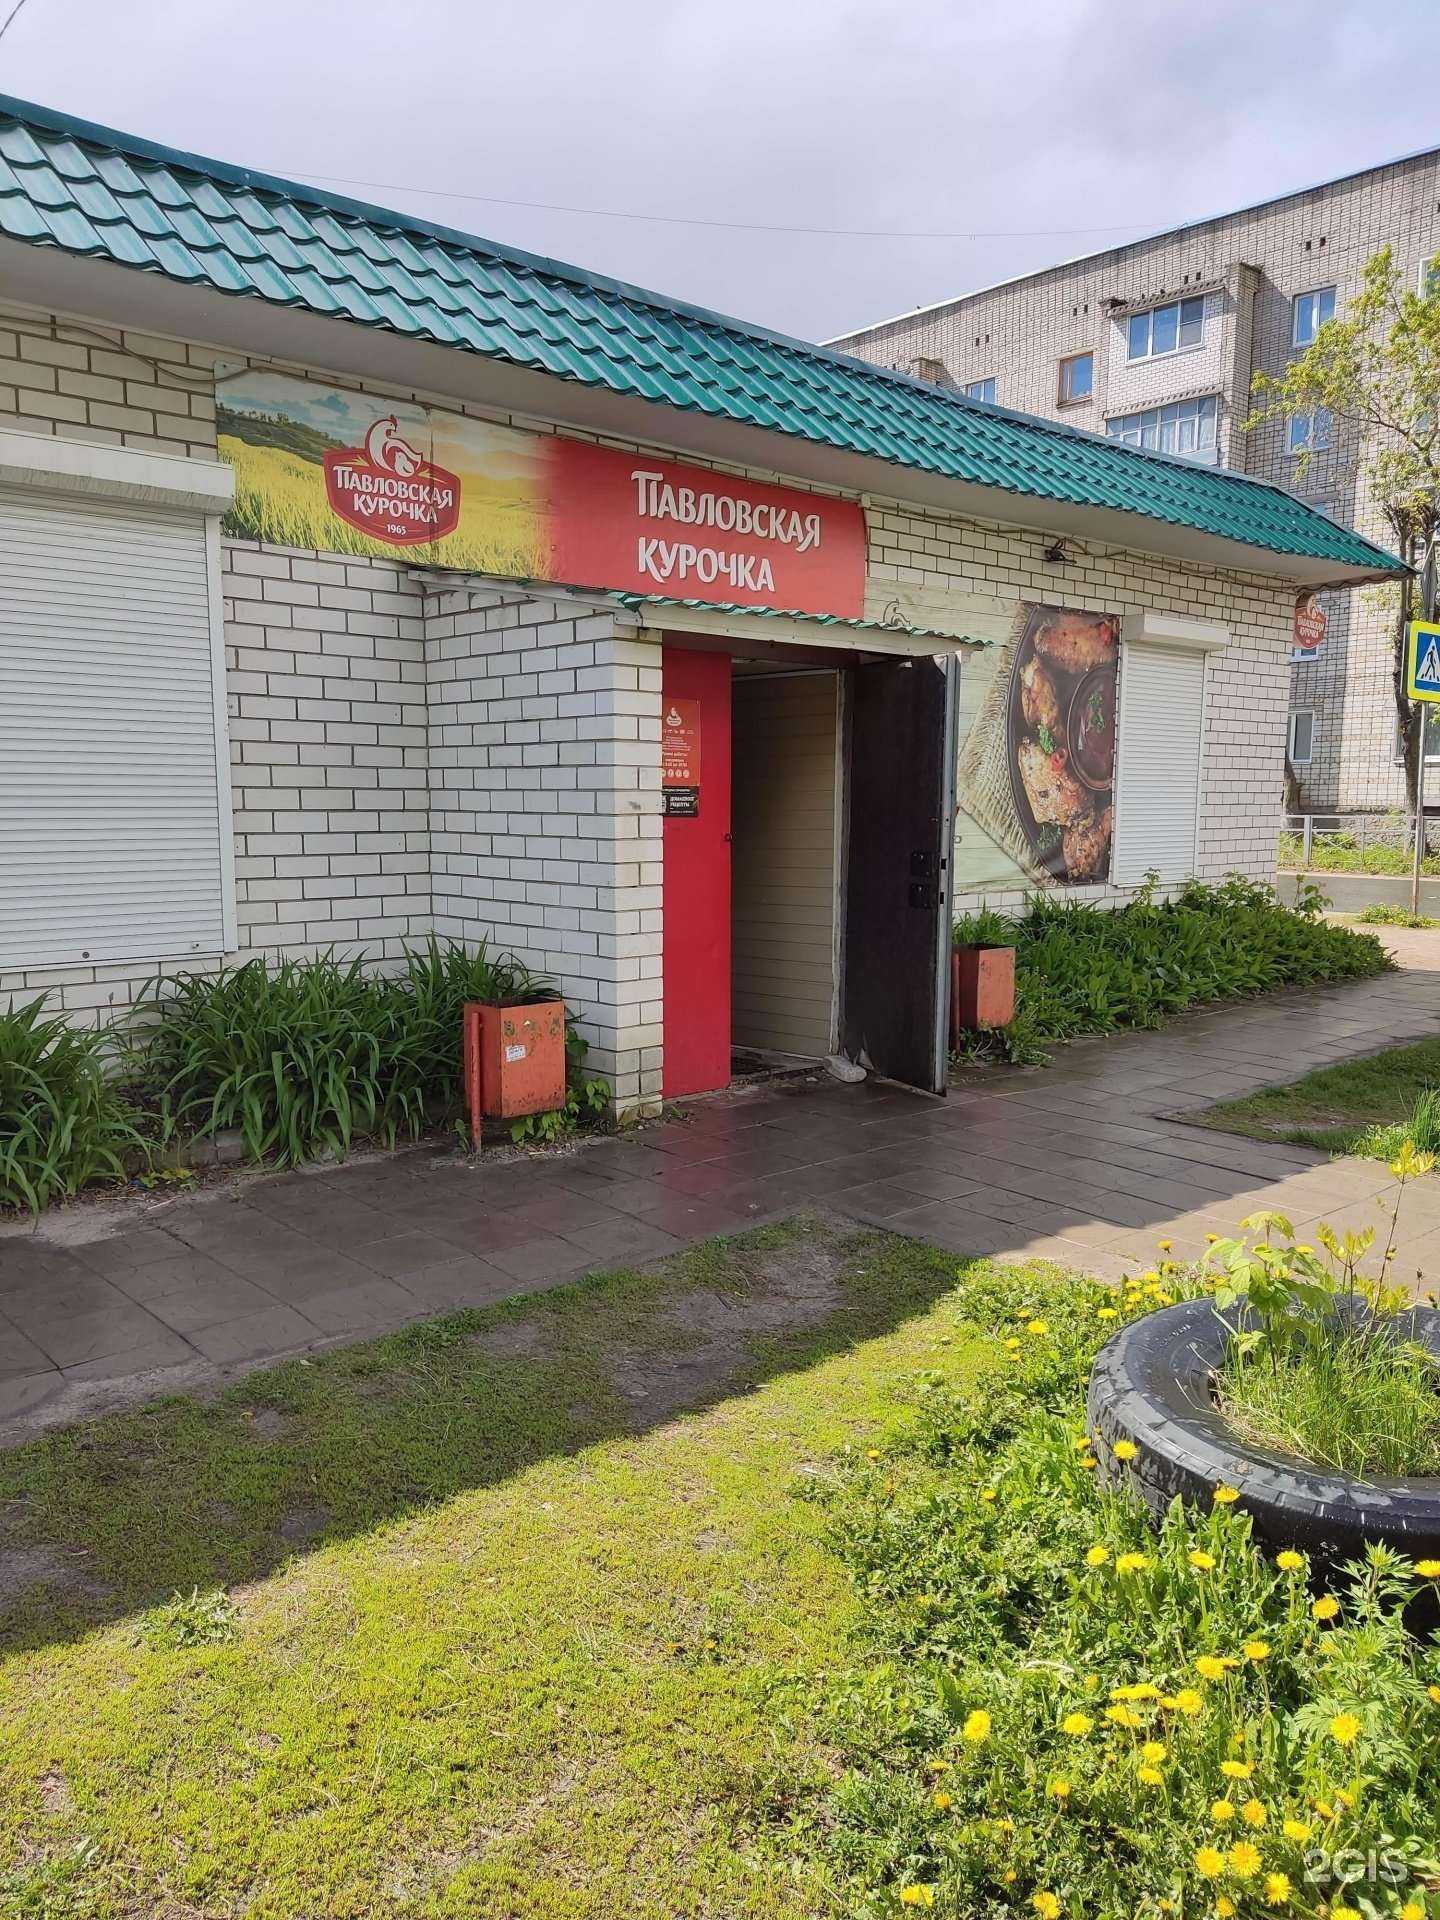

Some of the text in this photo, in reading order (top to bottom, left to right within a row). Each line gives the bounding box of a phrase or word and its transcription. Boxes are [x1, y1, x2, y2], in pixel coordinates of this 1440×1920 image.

[333, 465, 453, 509] ПАВЛОВСКАЯ
[353, 493, 438, 523] КУРОЧКА
[386, 523, 407, 536] 1965
[630, 470, 821, 552] ПАВЛОВСКАЯ
[638, 536, 776, 592] КУРОЧКА
